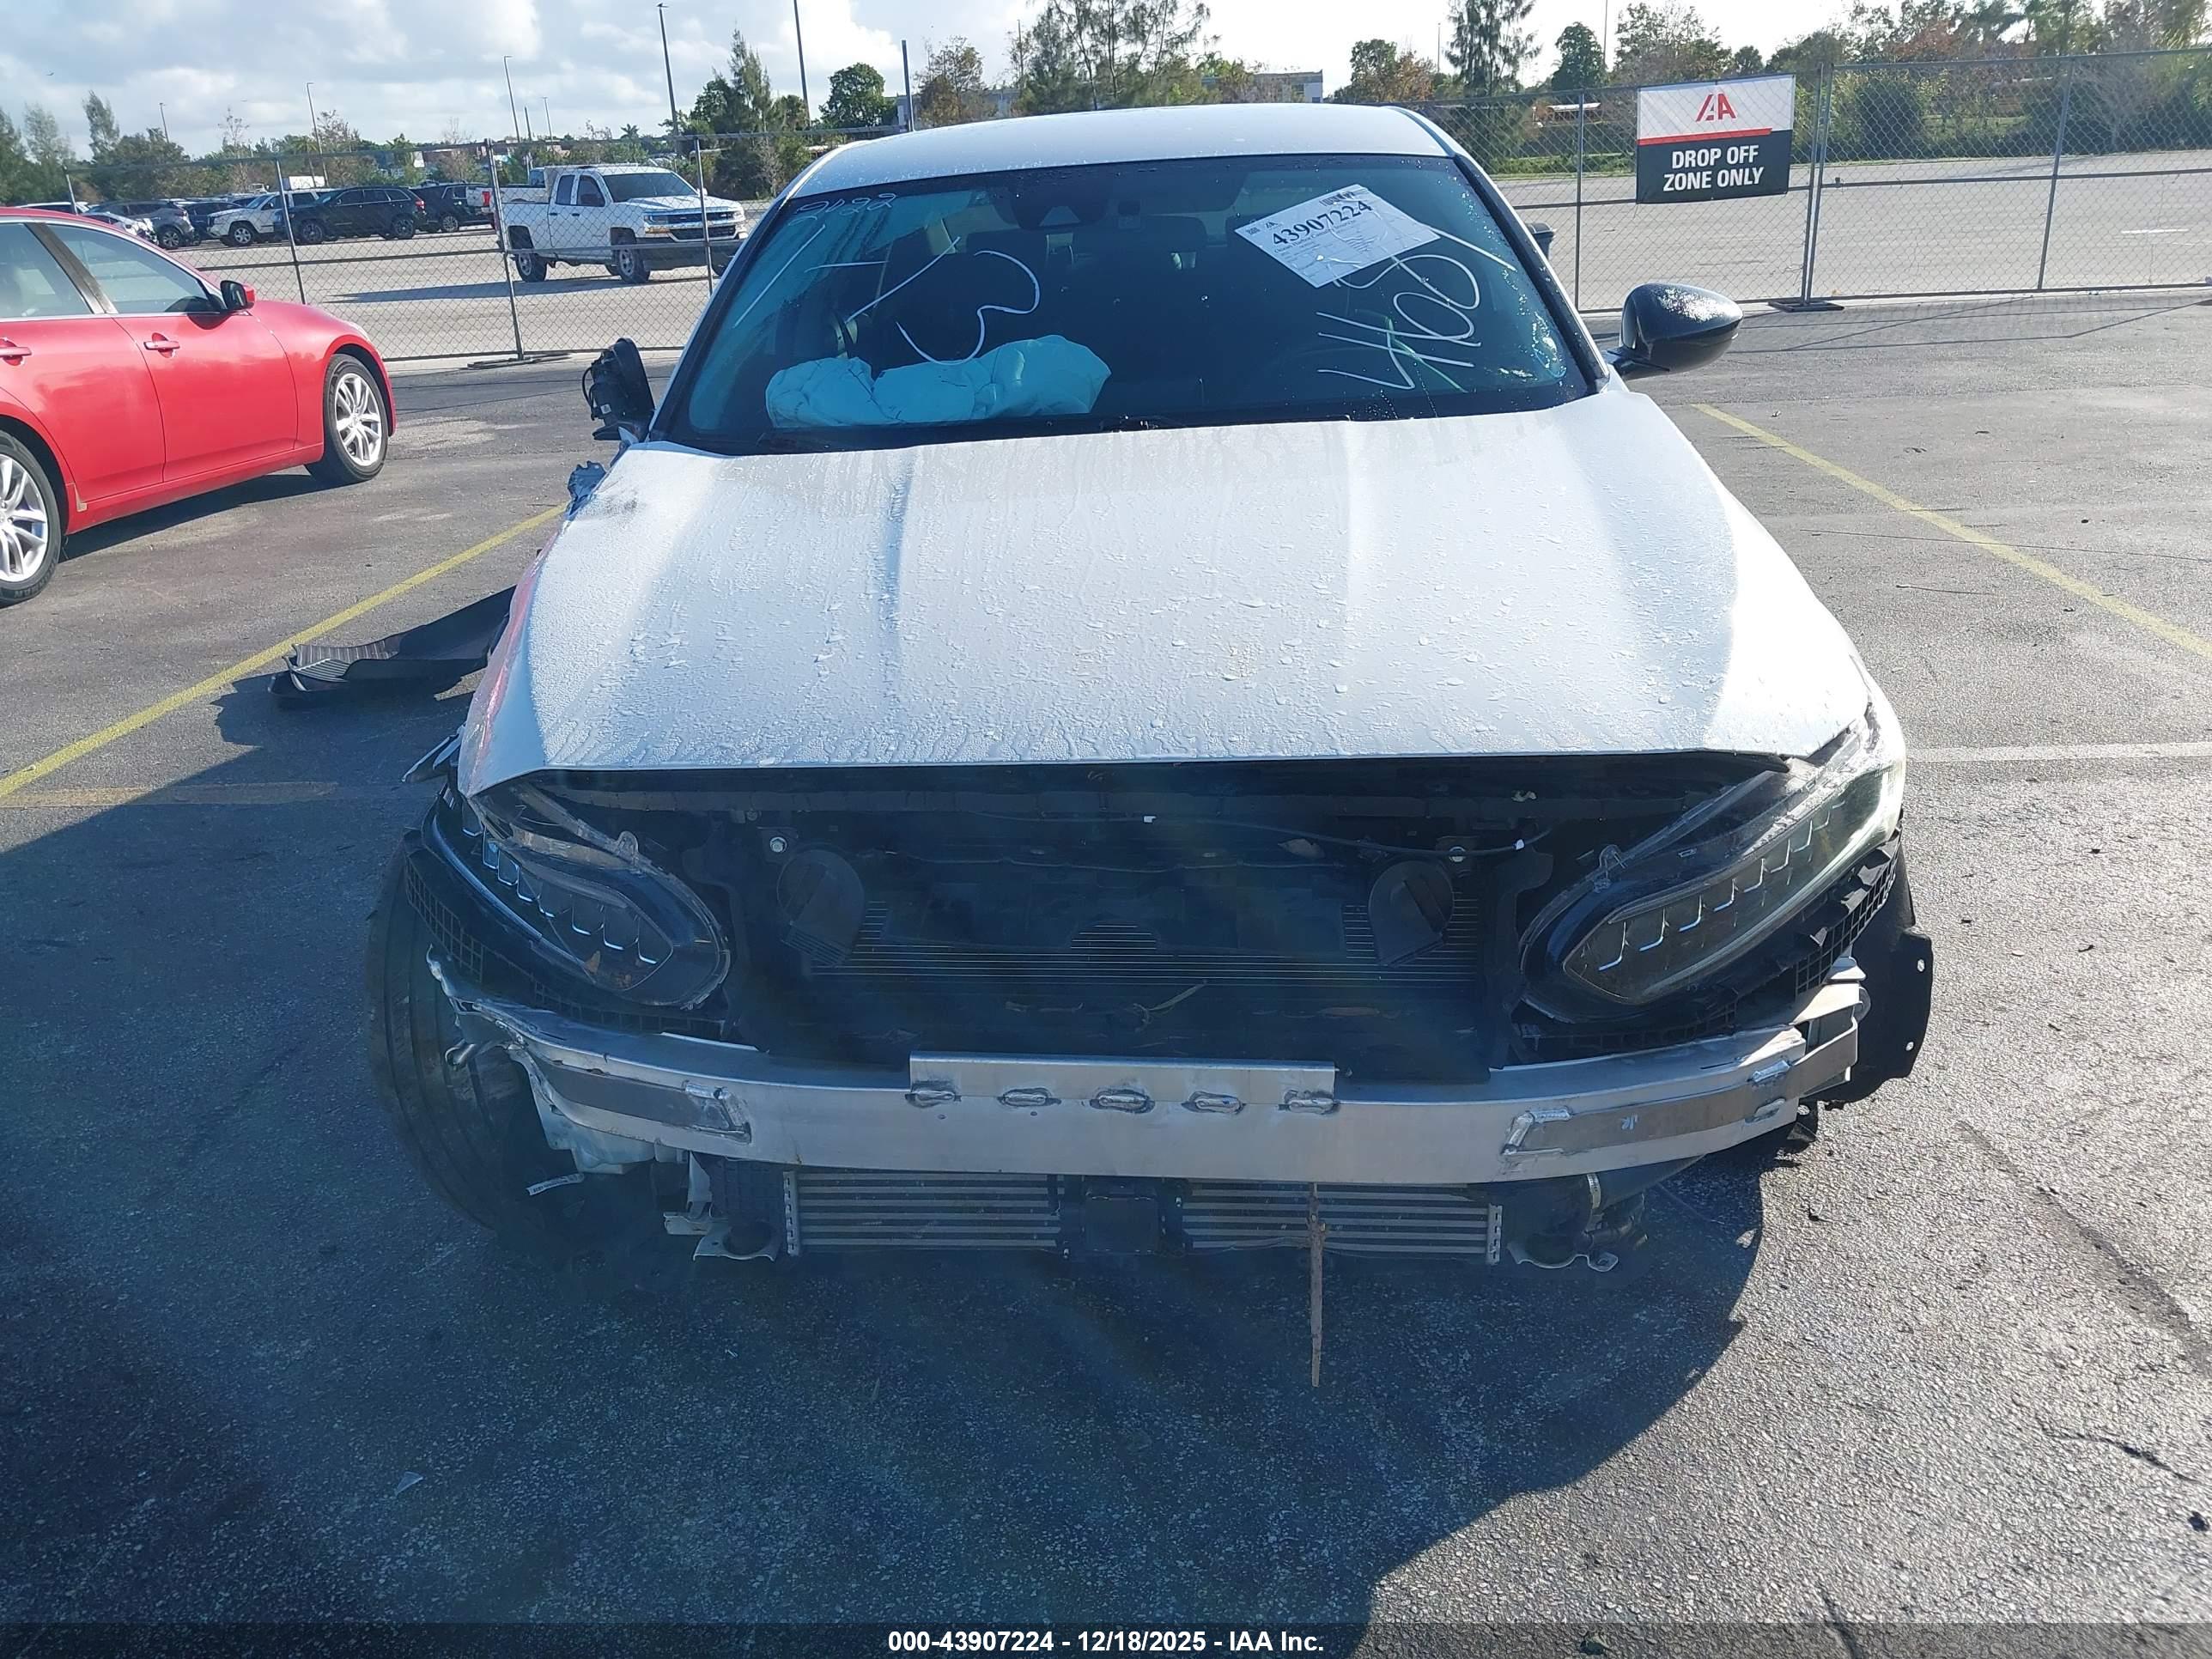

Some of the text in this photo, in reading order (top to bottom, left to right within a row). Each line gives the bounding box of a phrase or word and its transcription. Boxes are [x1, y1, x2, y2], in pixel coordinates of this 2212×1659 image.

[1672, 144, 1759, 169] DROP OFF
[1662, 166, 1765, 192] ZONE ONLY
[1273, 200, 1372, 245] 43907224
